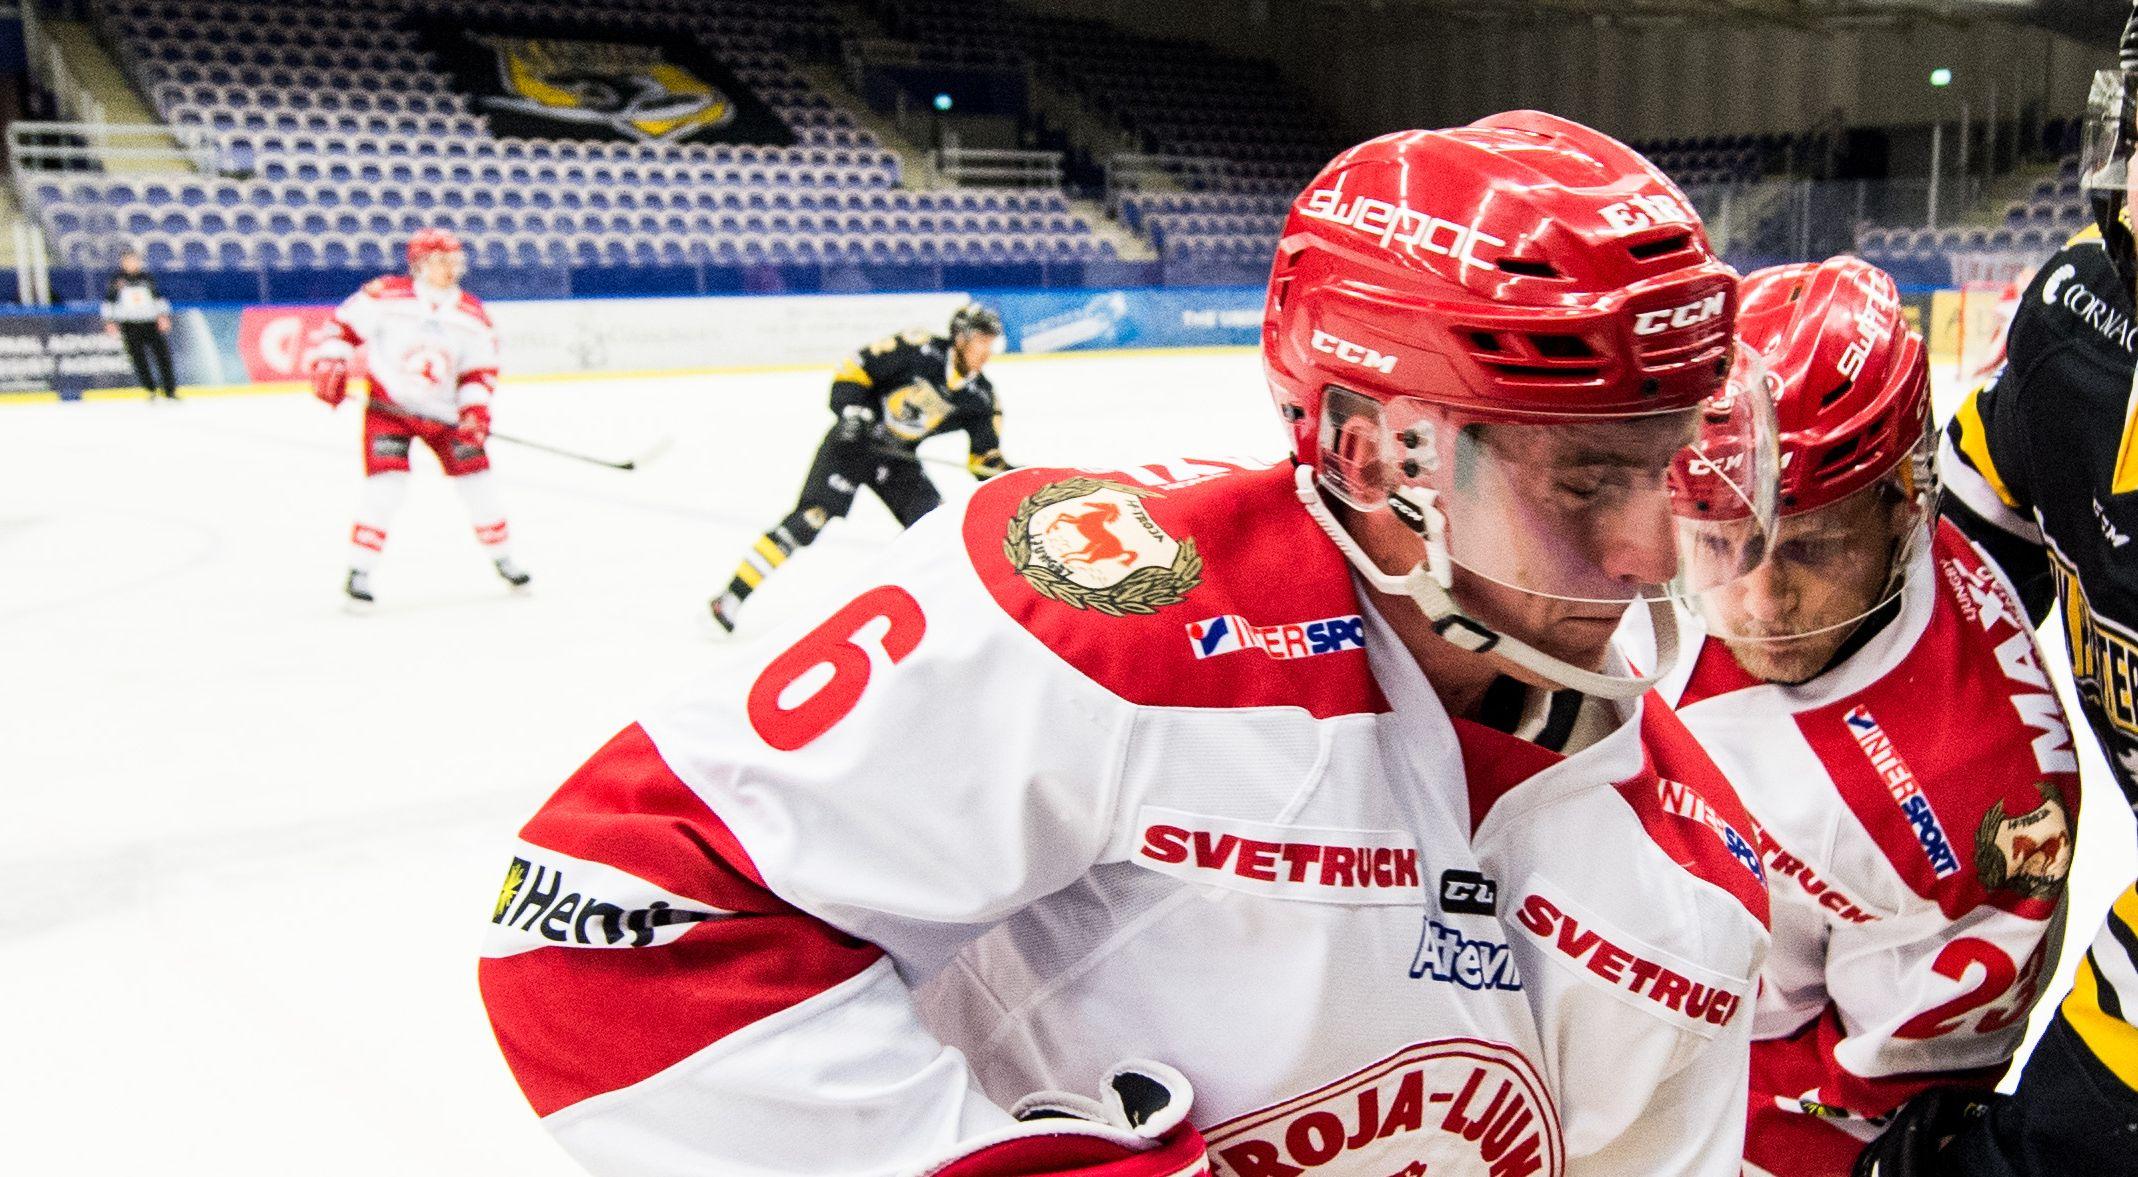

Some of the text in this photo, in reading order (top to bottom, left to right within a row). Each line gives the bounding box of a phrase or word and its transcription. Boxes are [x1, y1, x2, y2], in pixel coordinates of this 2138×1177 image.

[1633, 291, 1727, 335] CCM
[1310, 329, 1398, 374] CCM
[747, 584, 927, 752] 6
[1857, 728, 1959, 876] INTERSPORT
[1140, 823, 1420, 889] SVETRUCK
